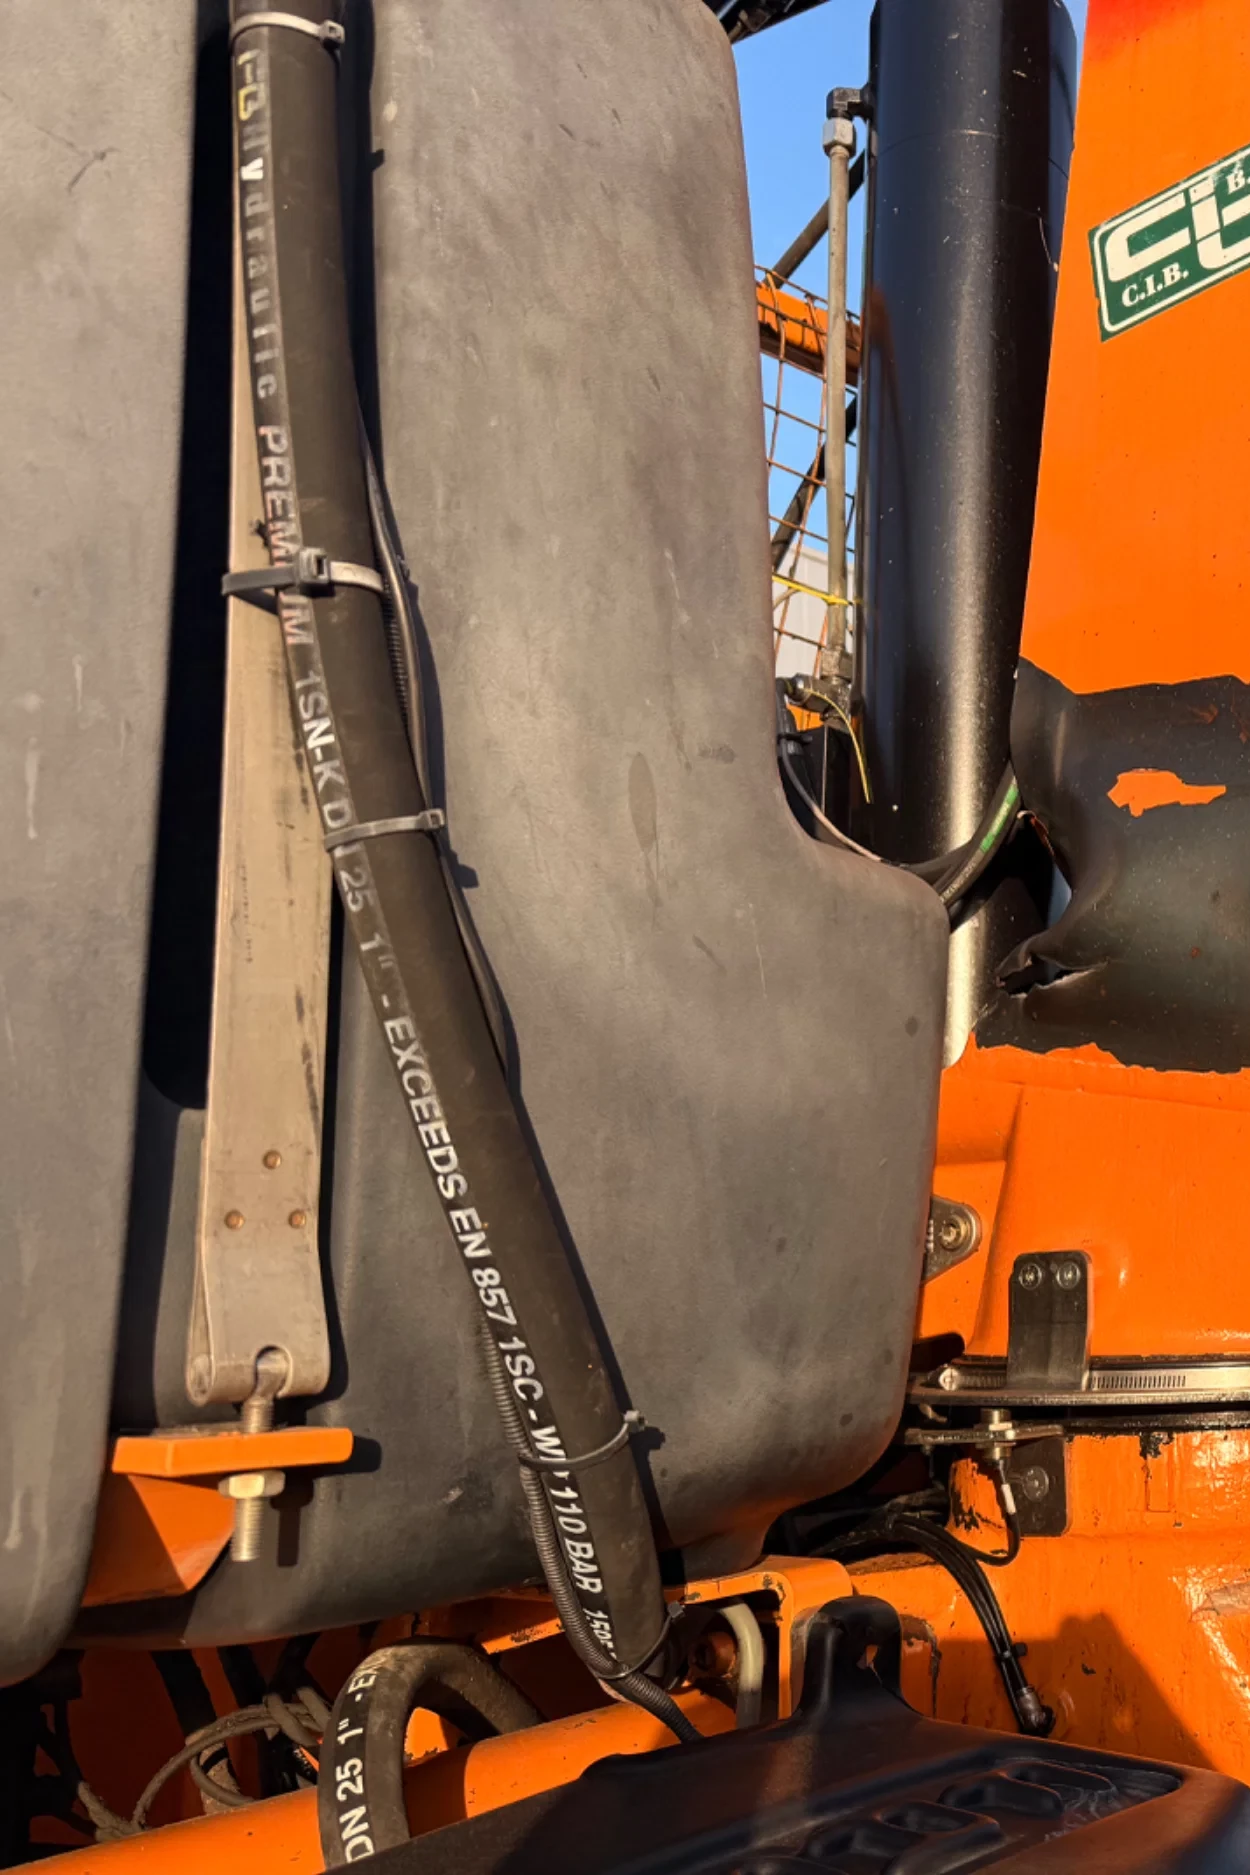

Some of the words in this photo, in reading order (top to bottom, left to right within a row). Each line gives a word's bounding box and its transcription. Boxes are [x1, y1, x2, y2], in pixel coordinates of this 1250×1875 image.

[1121, 262, 1190, 307] C.I.B.
[340, 867, 375, 913] 25
[383, 1016, 469, 1200] EXCEEDS
[449, 1207, 493, 1259] EN
[472, 1267, 518, 1326] 857
[499, 1336, 544, 1402] 1SC
[549, 1485, 588, 1535] 110
[564, 1541, 603, 1594] BAR
[336, 1757, 365, 1802] 25
[339, 1805, 375, 1863] DN
